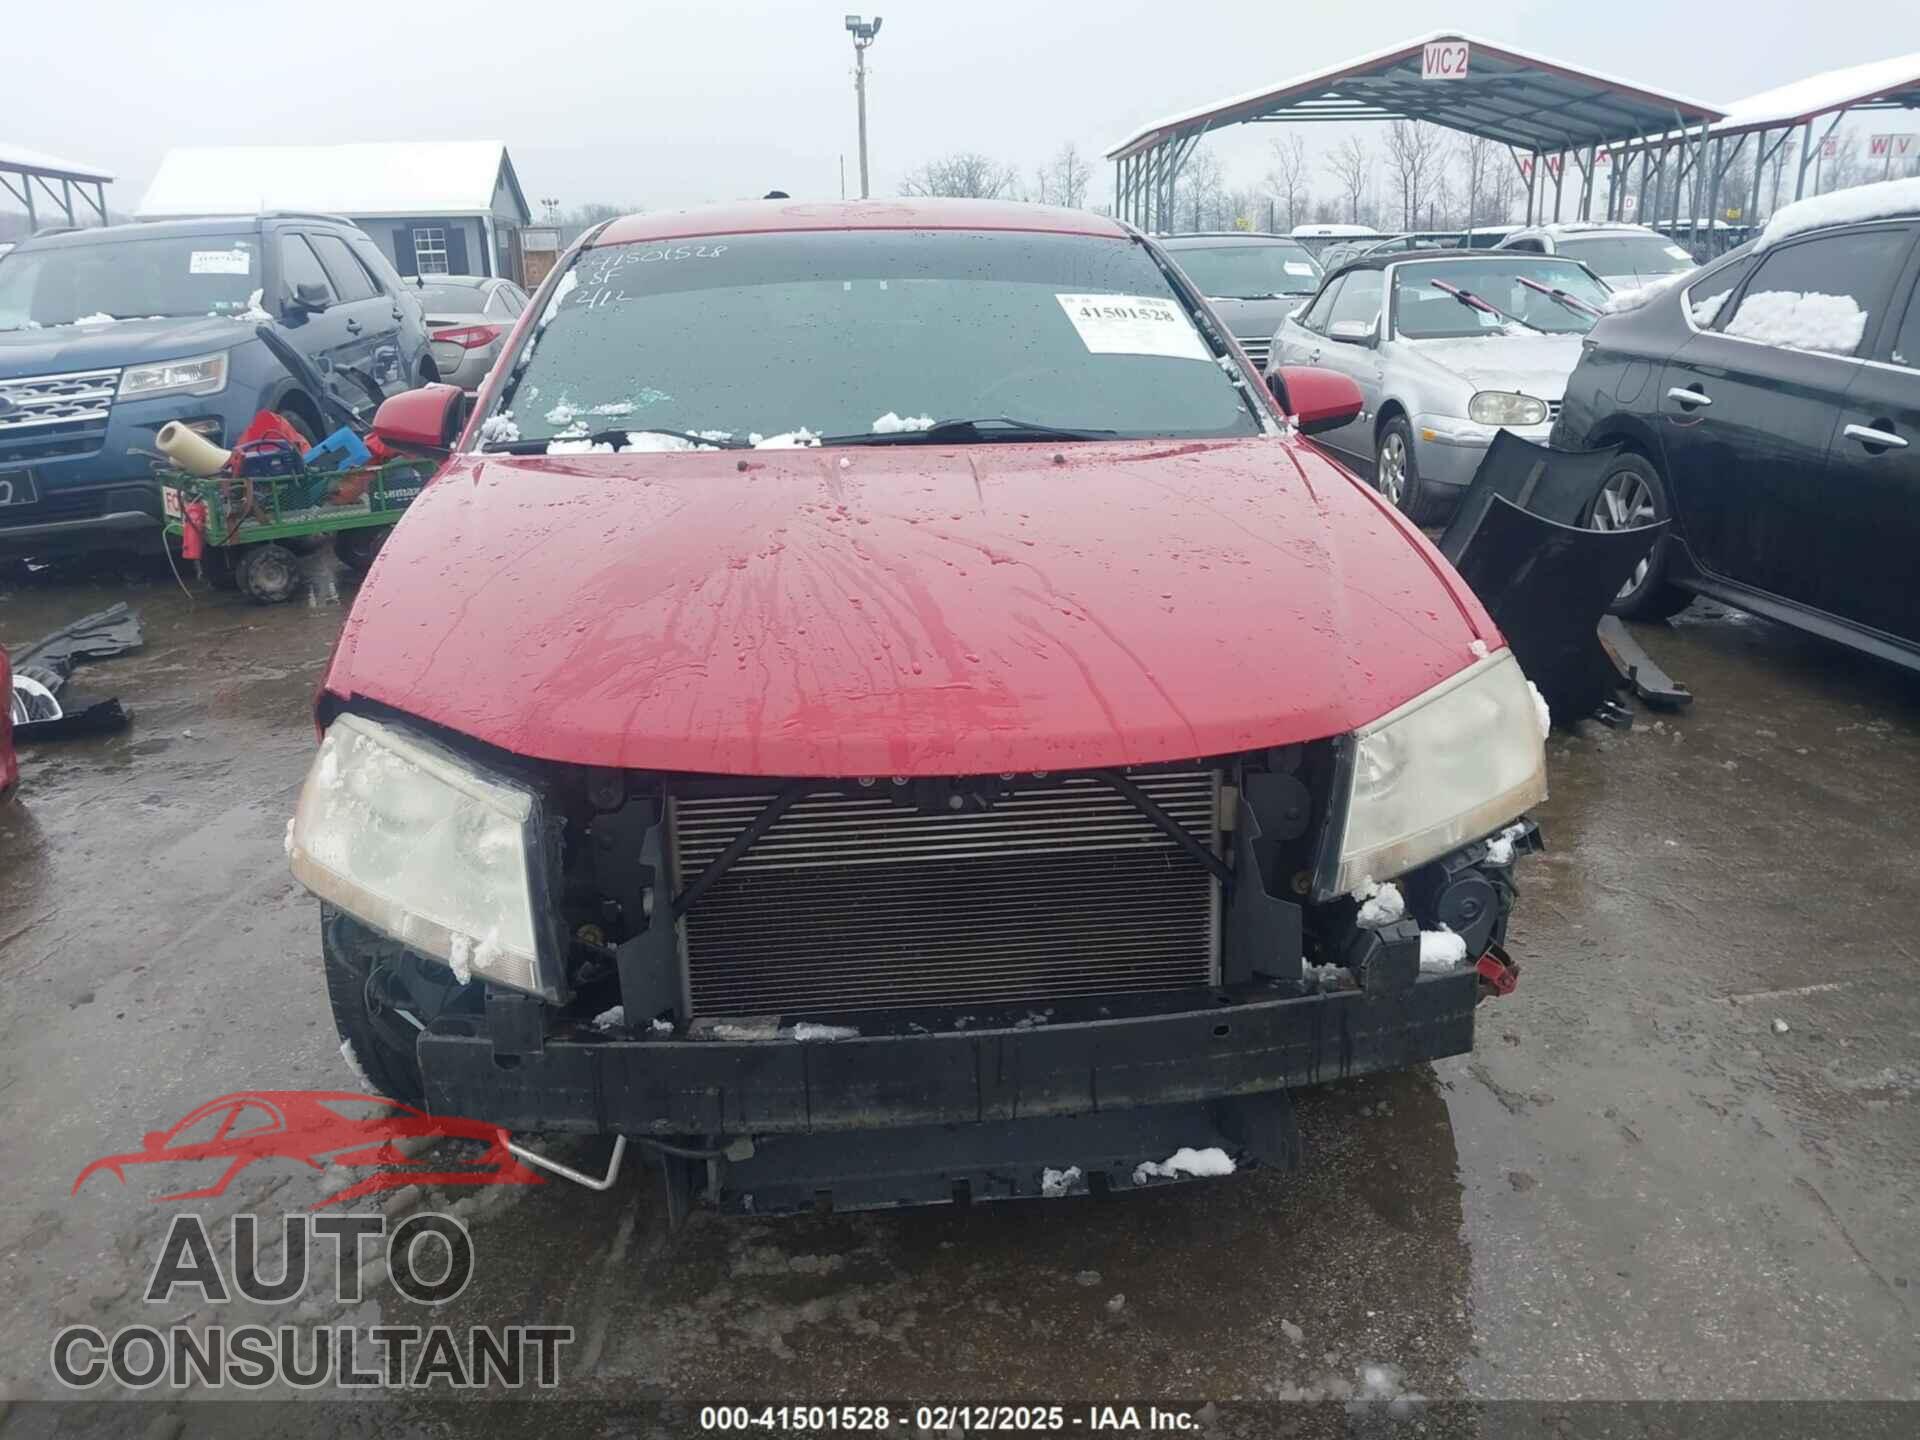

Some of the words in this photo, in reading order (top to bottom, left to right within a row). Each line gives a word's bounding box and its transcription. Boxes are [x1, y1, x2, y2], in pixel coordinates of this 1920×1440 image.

[1425, 47, 1452, 74] VIC
[1455, 47, 1467, 73] 2
[1871, 138, 1888, 154] W
[1898, 138, 1911, 153] V
[592, 245, 728, 271] 41501528
[1079, 306, 1175, 322] 41501528
